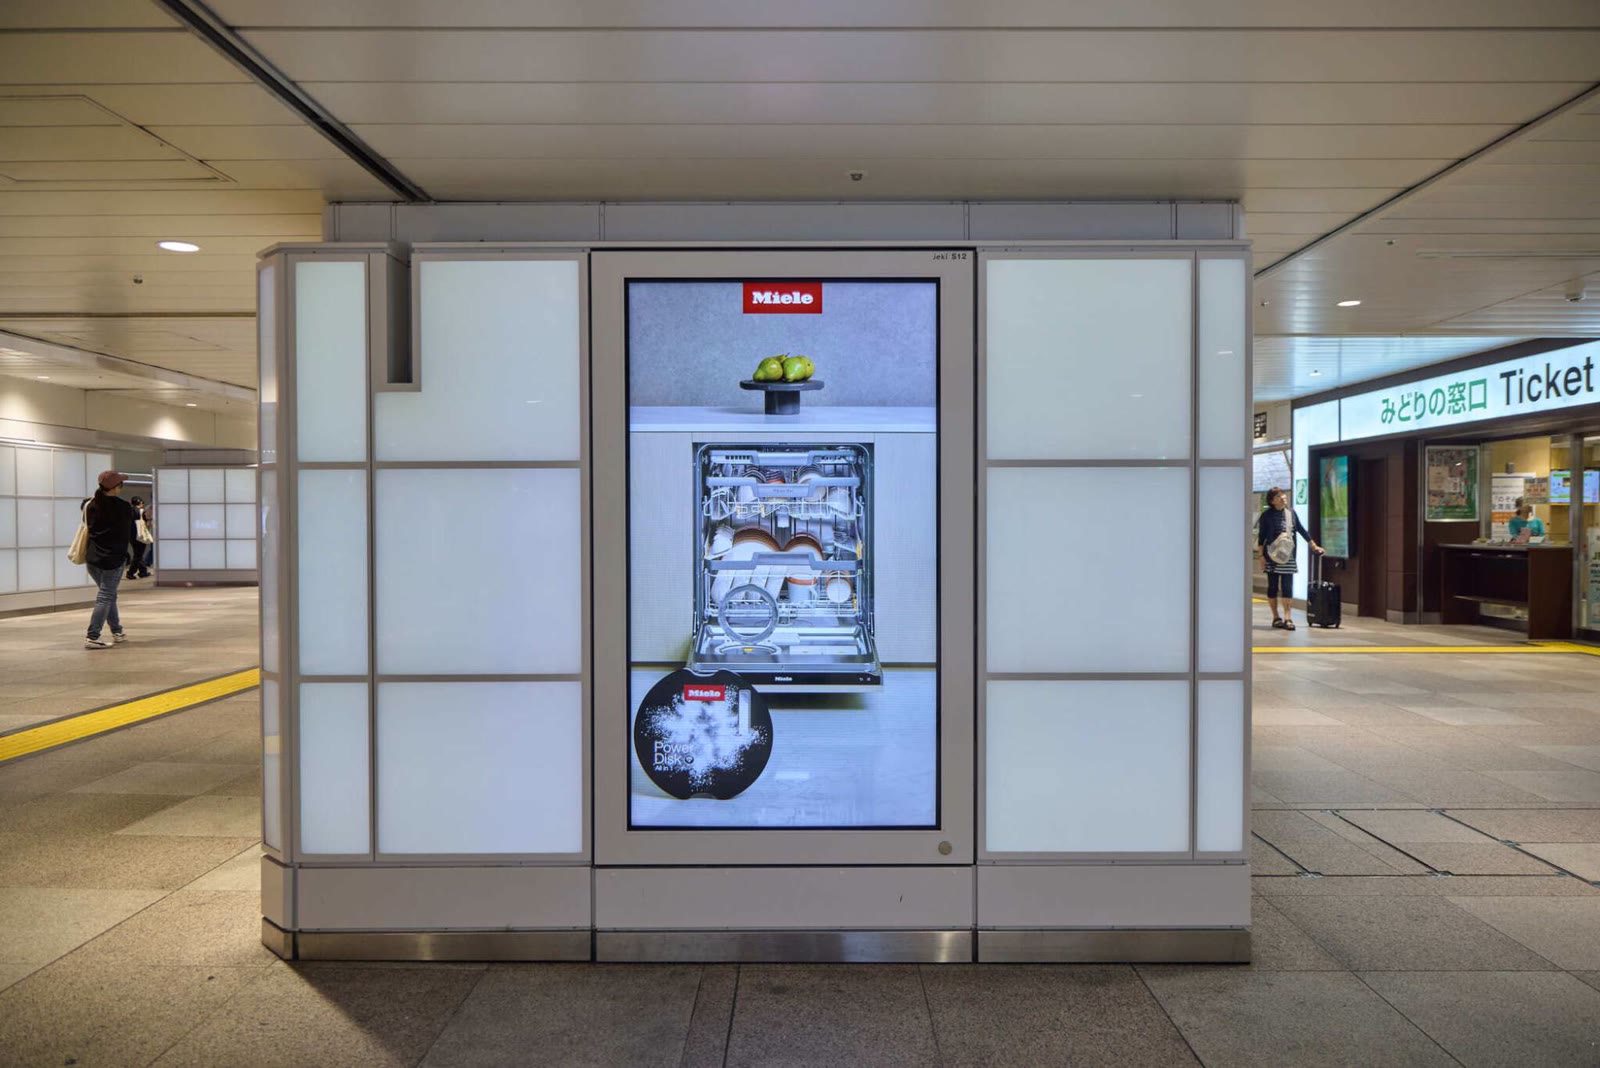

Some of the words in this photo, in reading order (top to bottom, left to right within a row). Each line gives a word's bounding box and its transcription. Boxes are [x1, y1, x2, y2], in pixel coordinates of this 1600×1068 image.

[951, 252, 968, 260] S12
[751, 290, 814, 305] Miele
[1499, 356, 1595, 406] Ticket
[1380, 377, 1488, 425] みどりの窓口
[688, 689, 721, 698] Miele
[654, 740, 694, 754] Power
[654, 753, 682, 765] Disk
